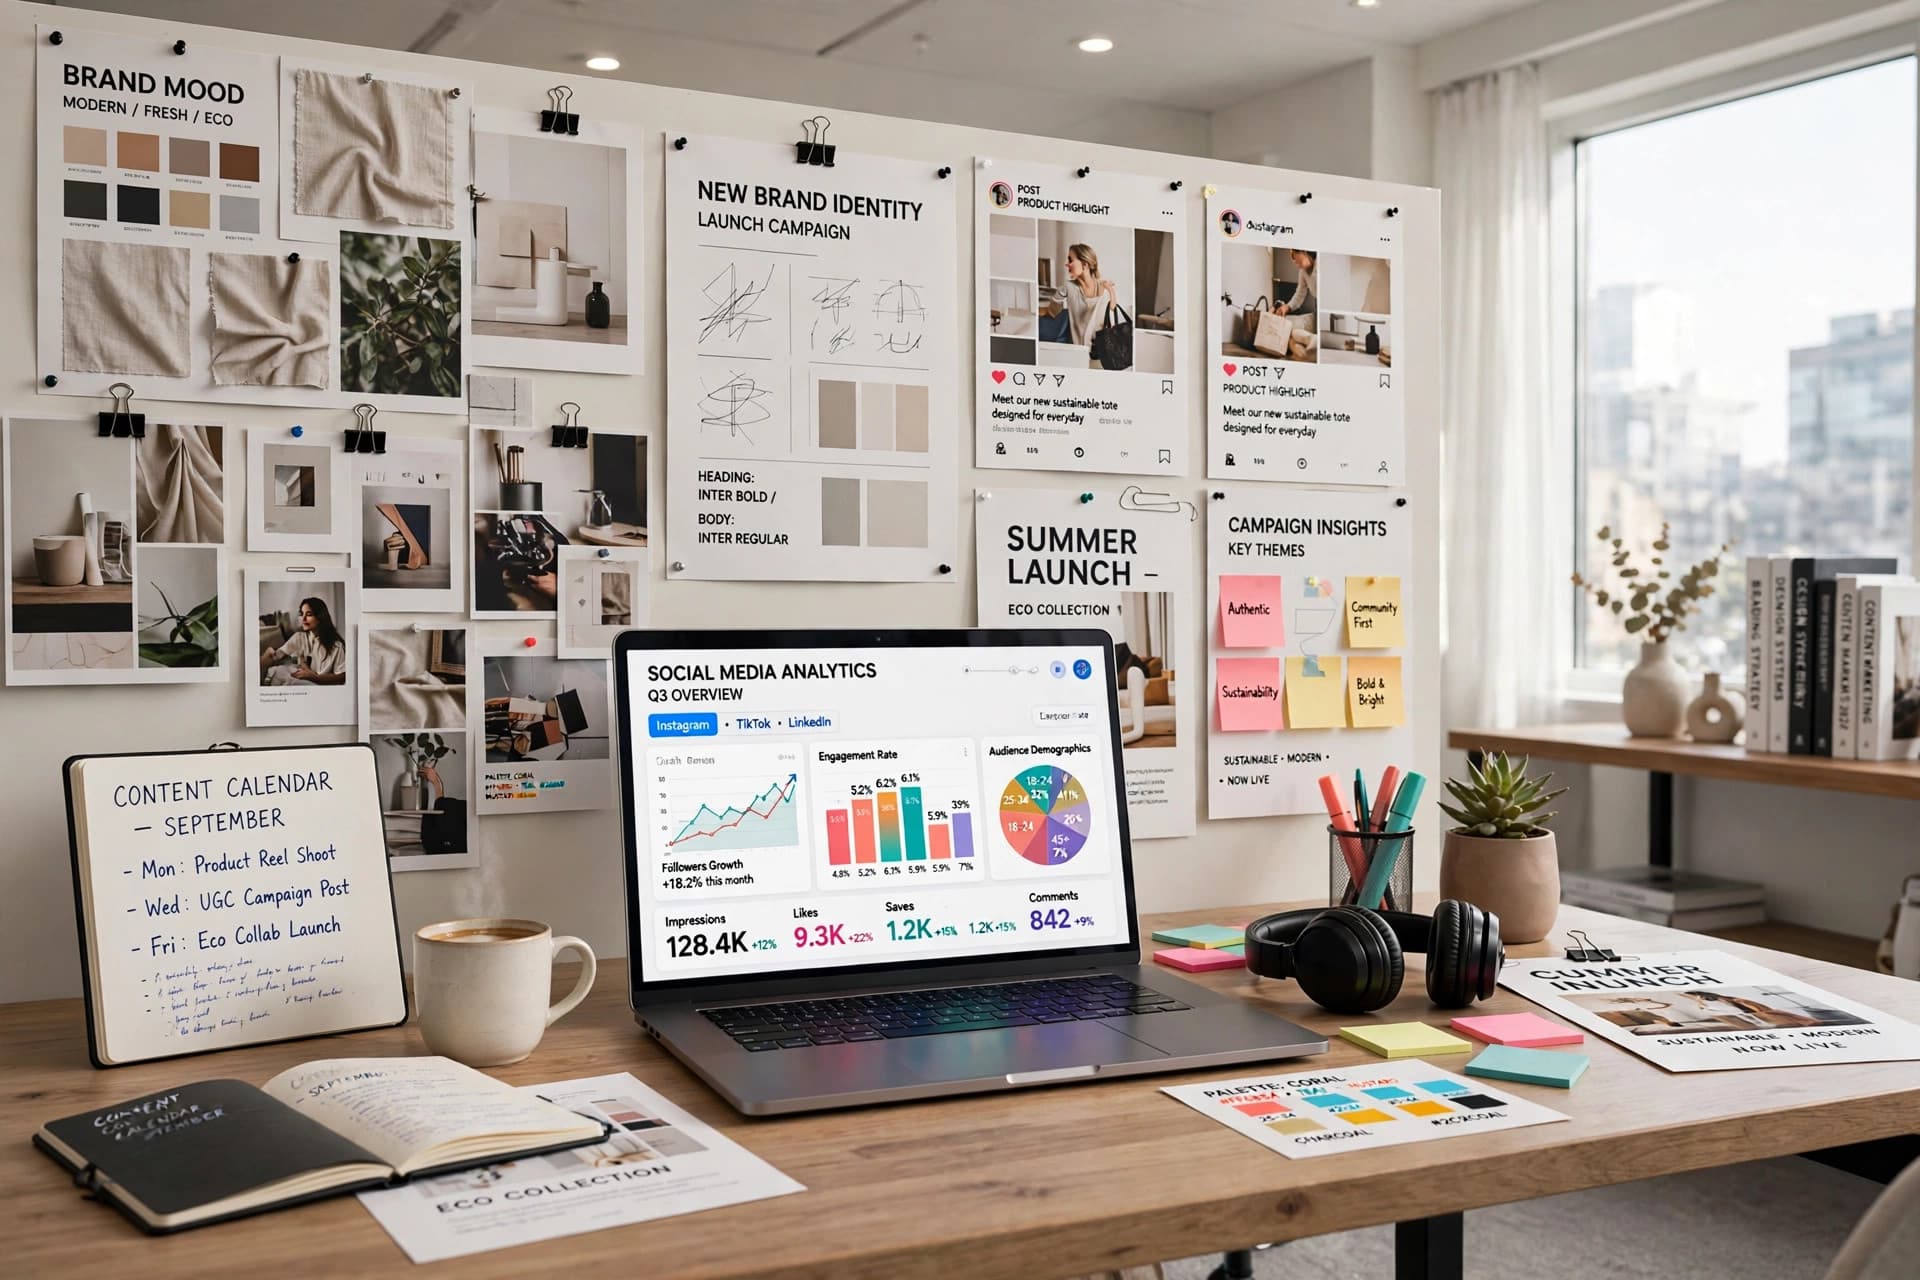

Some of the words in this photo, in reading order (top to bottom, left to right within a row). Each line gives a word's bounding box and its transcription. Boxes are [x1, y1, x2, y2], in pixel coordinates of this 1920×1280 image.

[63, 63, 156, 95] BRAND
[164, 75, 245, 105] MOOD
[63, 96, 127, 116] MODERN
[144, 105, 188, 123] FRESH
[204, 111, 234, 127] ECO
[1017, 184, 1041, 196] POST
[698, 180, 748, 204] NEW
[754, 186, 827, 212] BRAND
[833, 193, 923, 222] IDENTITY
[1017, 197, 1061, 212] PRODUCT
[1062, 201, 1110, 216] HIGHLIGHT
[698, 212, 764, 233] LAUNCH
[768, 218, 851, 241] CAMPAIGN
[1243, 366, 1268, 377] POST
[1223, 383, 1266, 395] PRODUCT
[1269, 386, 1317, 398] HIGHLIGHT
[992, 393, 1014, 405] Meet
[1016, 398, 1031, 406] our
[1033, 398, 1050, 407] new
[1053, 398, 1099, 410] sustainable
[1102, 400, 1118, 410] tote
[992, 409, 1030, 422] designed
[1033, 410, 1044, 421] for
[1047, 412, 1084, 425] everyday
[1223, 405, 1245, 416] Meet
[1248, 407, 1262, 417] our
[1264, 409, 1282, 418] new
[1284, 409, 1332, 421] sustainable
[1334, 412, 1351, 423] tote
[1223, 422, 1262, 436] designed
[1264, 424, 1277, 435] for
[1279, 425, 1317, 439] everyday
[698, 470, 755, 484] HEADING:
[698, 489, 732, 502] INTER
[735, 490, 768, 503] BOLD
[698, 513, 735, 526] BODY:
[1228, 516, 1313, 536] CAMPAIGN
[1317, 519, 1387, 537] INSIGHTS
[698, 532, 732, 545] INTER
[735, 533, 789, 546] REGULAR
[1007, 525, 1137, 554] SUMMER
[1228, 542, 1251, 556] KEY
[1256, 543, 1305, 558] THEMES
[1008, 558, 1132, 586] LAUNCH
[1008, 604, 1033, 616] ECO
[1037, 604, 1110, 616] COLLECTION
[1228, 601, 1270, 617] Authentic
[1352, 601, 1397, 617] Community
[1354, 616, 1373, 629] First
[647, 664, 714, 682] SOCIAL
[719, 664, 777, 682] MEDIA
[781, 662, 877, 680] ANALYTICS
[1357, 678, 1375, 690] Bold
[647, 689, 668, 703] Q3
[671, 687, 743, 702] OVERVIEW
[1222, 684, 1279, 701] Sustainability
[1359, 692, 1385, 709] Bright
[656, 719, 710, 734] Instagram
[736, 716, 771, 730] TikTok
[788, 715, 832, 729] LinkedIn
[819, 751, 875, 763] Engagement
[877, 750, 898, 760] Rate
[989, 745, 1029, 756] Audience
[1031, 744, 1091, 756] Demographics
[1224, 754, 1278, 766] SUSTAINABLE
[1287, 752, 1322, 763] MODERN
[901, 773, 920, 783] 6.1%
[1227, 775, 1248, 785] NOW
[1250, 774, 1270, 785] LIVE
[114, 779, 213, 808] CONTENT
[227, 771, 333, 798] CALENDAR
[165, 808, 286, 837] SEPTEMBER
[195, 851, 251, 875] Product
[259, 848, 289, 868] Reel
[297, 844, 337, 864] Shoot
[662, 861, 707, 873] Followers
[709, 859, 743, 871] Growth
[662, 876, 702, 889] +18.2%
[706, 876, 723, 886] this
[725, 874, 754, 885] month
[200, 889, 235, 912] UGC
[244, 884, 313, 910] Campaign
[320, 878, 350, 897] Post
[1029, 890, 1079, 902] Comments
[793, 907, 818, 918] Likes
[885, 902, 915, 912] Saves
[665, 914, 726, 928] Impressions
[1030, 908, 1071, 931] 842
[1074, 915, 1095, 927] +9%
[198, 930, 226, 951] Eco
[235, 923, 281, 945] Collab
[289, 915, 341, 938] Launch
[794, 923, 846, 948] 9.3K
[848, 933, 874, 944] +22%
[886, 918, 933, 941] 1.2K
[969, 921, 994, 935] 1.2K
[666, 931, 748, 958] 128.4K
[752, 939, 777, 951] +12%
[1657, 1031, 1780, 1046] SUSTAINABLE
[1803, 1028, 1880, 1040] MODERN
[1734, 1043, 1787, 1055] NOW
[1795, 1040, 1848, 1052] LIVE
[1287, 1075, 1346, 1088] CORAL
[1294, 1129, 1374, 1145] CHARCOAL
[437, 1196, 493, 1213] ECO
[504, 1164, 671, 1201] COLLECTION
